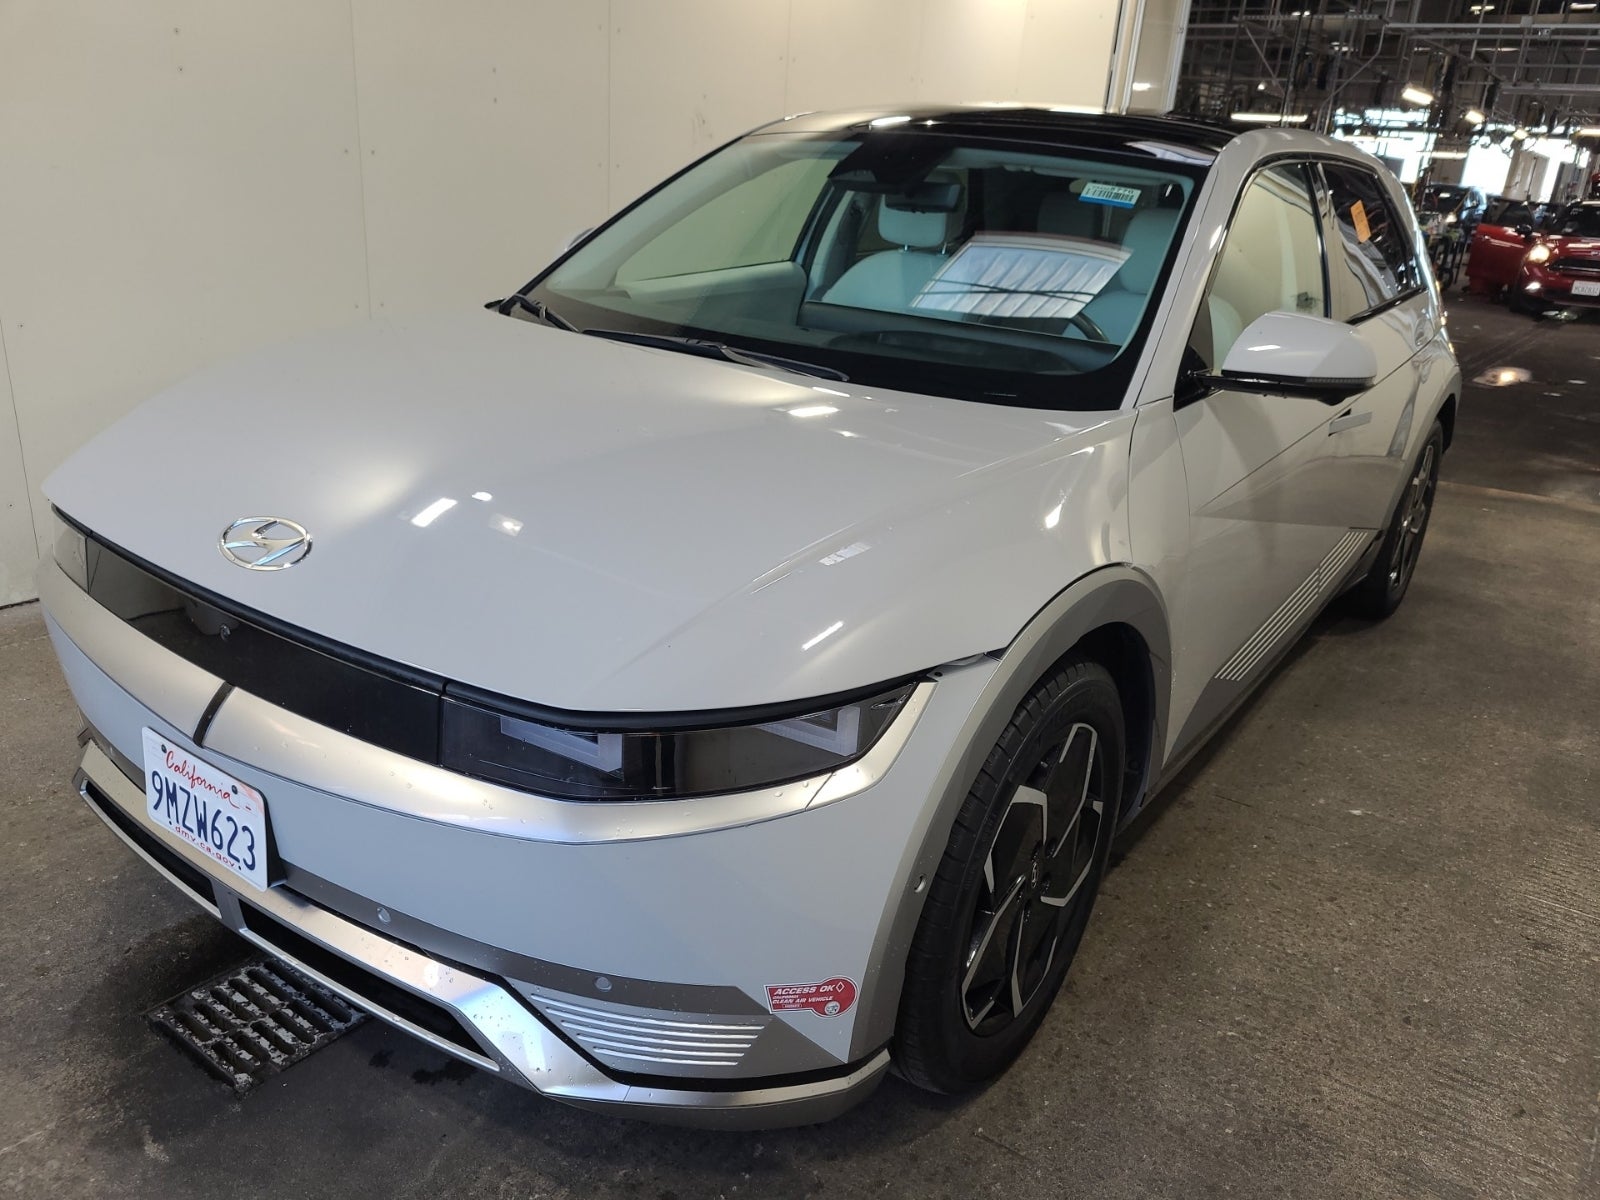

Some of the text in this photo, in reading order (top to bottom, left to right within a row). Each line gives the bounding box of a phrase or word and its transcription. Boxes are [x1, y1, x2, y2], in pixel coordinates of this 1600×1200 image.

[166, 750, 240, 809] California
[151, 770, 256, 871] 9MZW623
[175, 825, 235, 868] dmv.ca.gov
[774, 984, 835, 995] ACCESS OK
